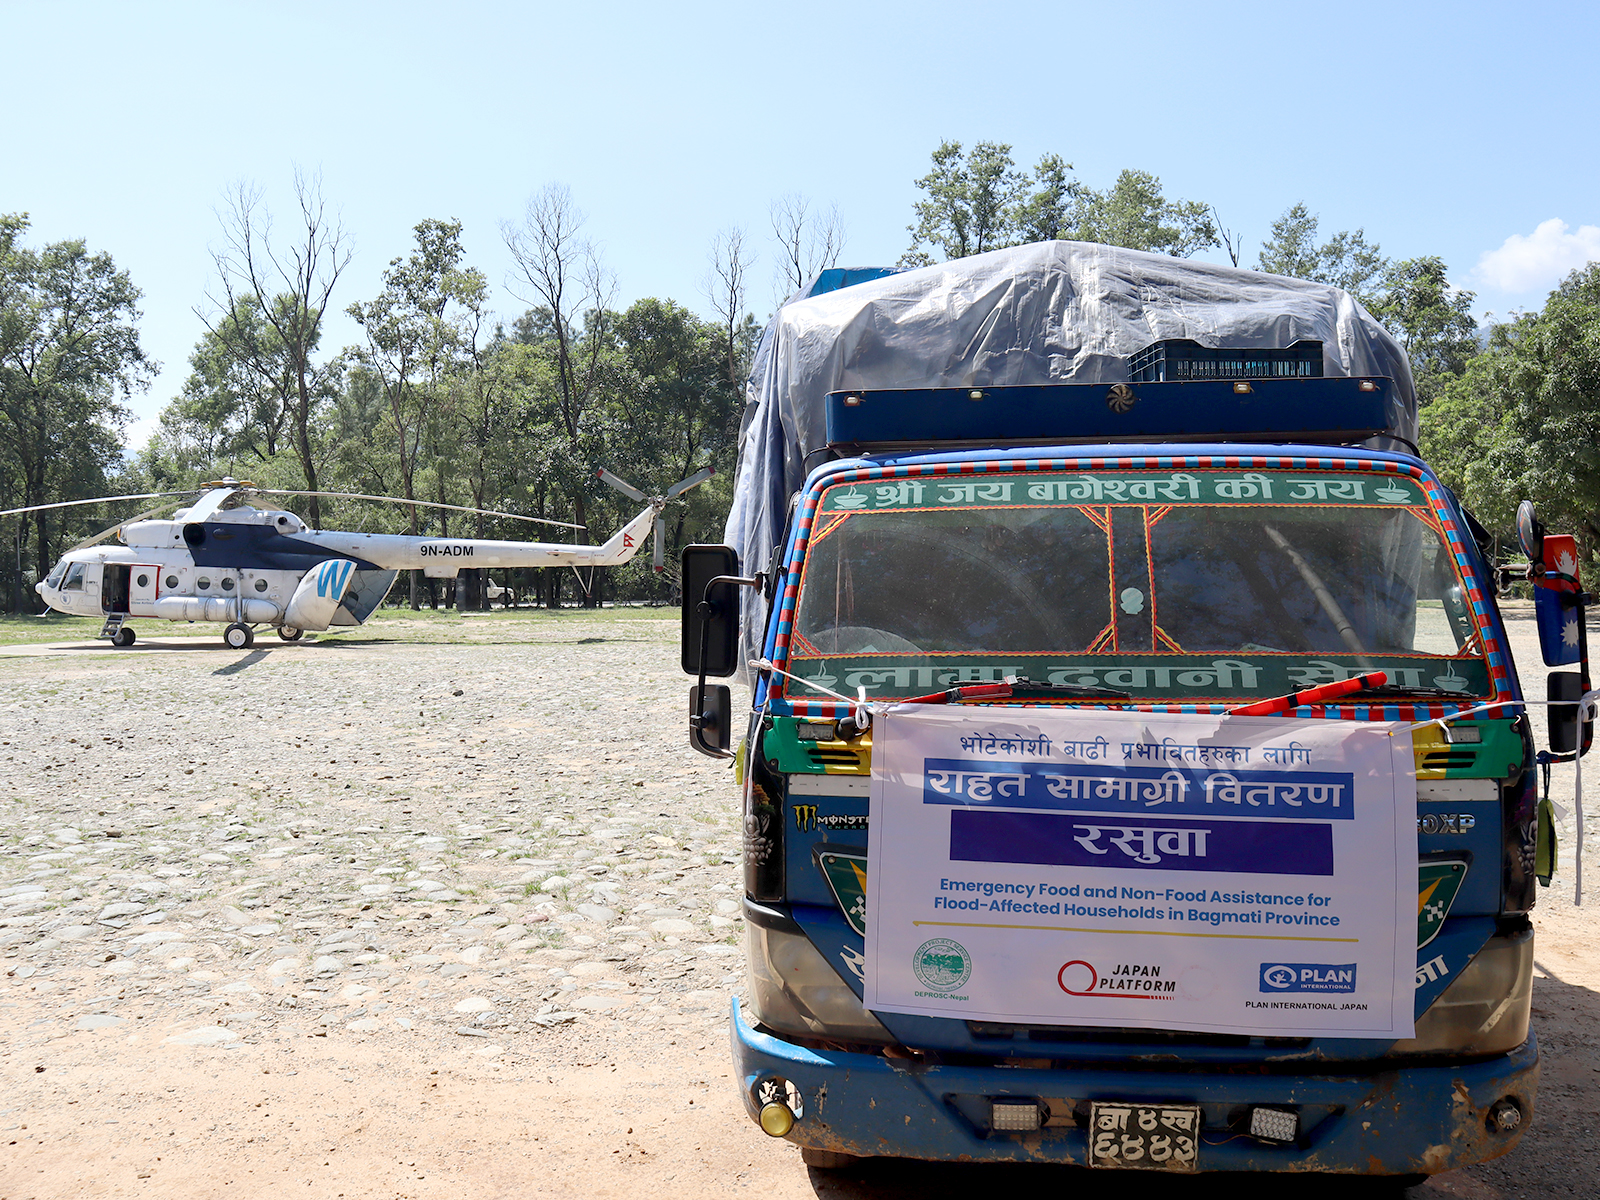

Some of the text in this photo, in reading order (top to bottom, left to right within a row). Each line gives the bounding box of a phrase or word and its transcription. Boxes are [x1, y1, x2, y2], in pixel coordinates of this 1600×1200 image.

[875, 472, 1366, 507] श्री जय बागेश्वरी की जय
[420, 545, 474, 557] 9N-ADM
[844, 665, 1024, 690] लामा
[1286, 660, 1426, 689] सेा
[960, 732, 1312, 767] भोटेकोशी बाढी प्रभावितहरुका लागि
[927, 766, 1346, 808] राहत सामाग्री वितरण
[1072, 824, 1212, 864] रसुवा
[940, 878, 1332, 907] Emergency Food and Non-Food Assistance for
[934, 896, 1341, 927] Flood-Affected Households in Bagmati Province
[1099, 978, 1176, 992] PLATFORM
[1112, 964, 1161, 977] JAPAN
[1300, 968, 1353, 983] PLAN
[914, 990, 970, 1001] DEPROSC-Nepal
[1245, 1001, 1368, 1011] PLAN INTERNATIONAL JAPAN
[1097, 1107, 1196, 1133] बा ४ ख
[1094, 1132, 1195, 1167] ६४४३
